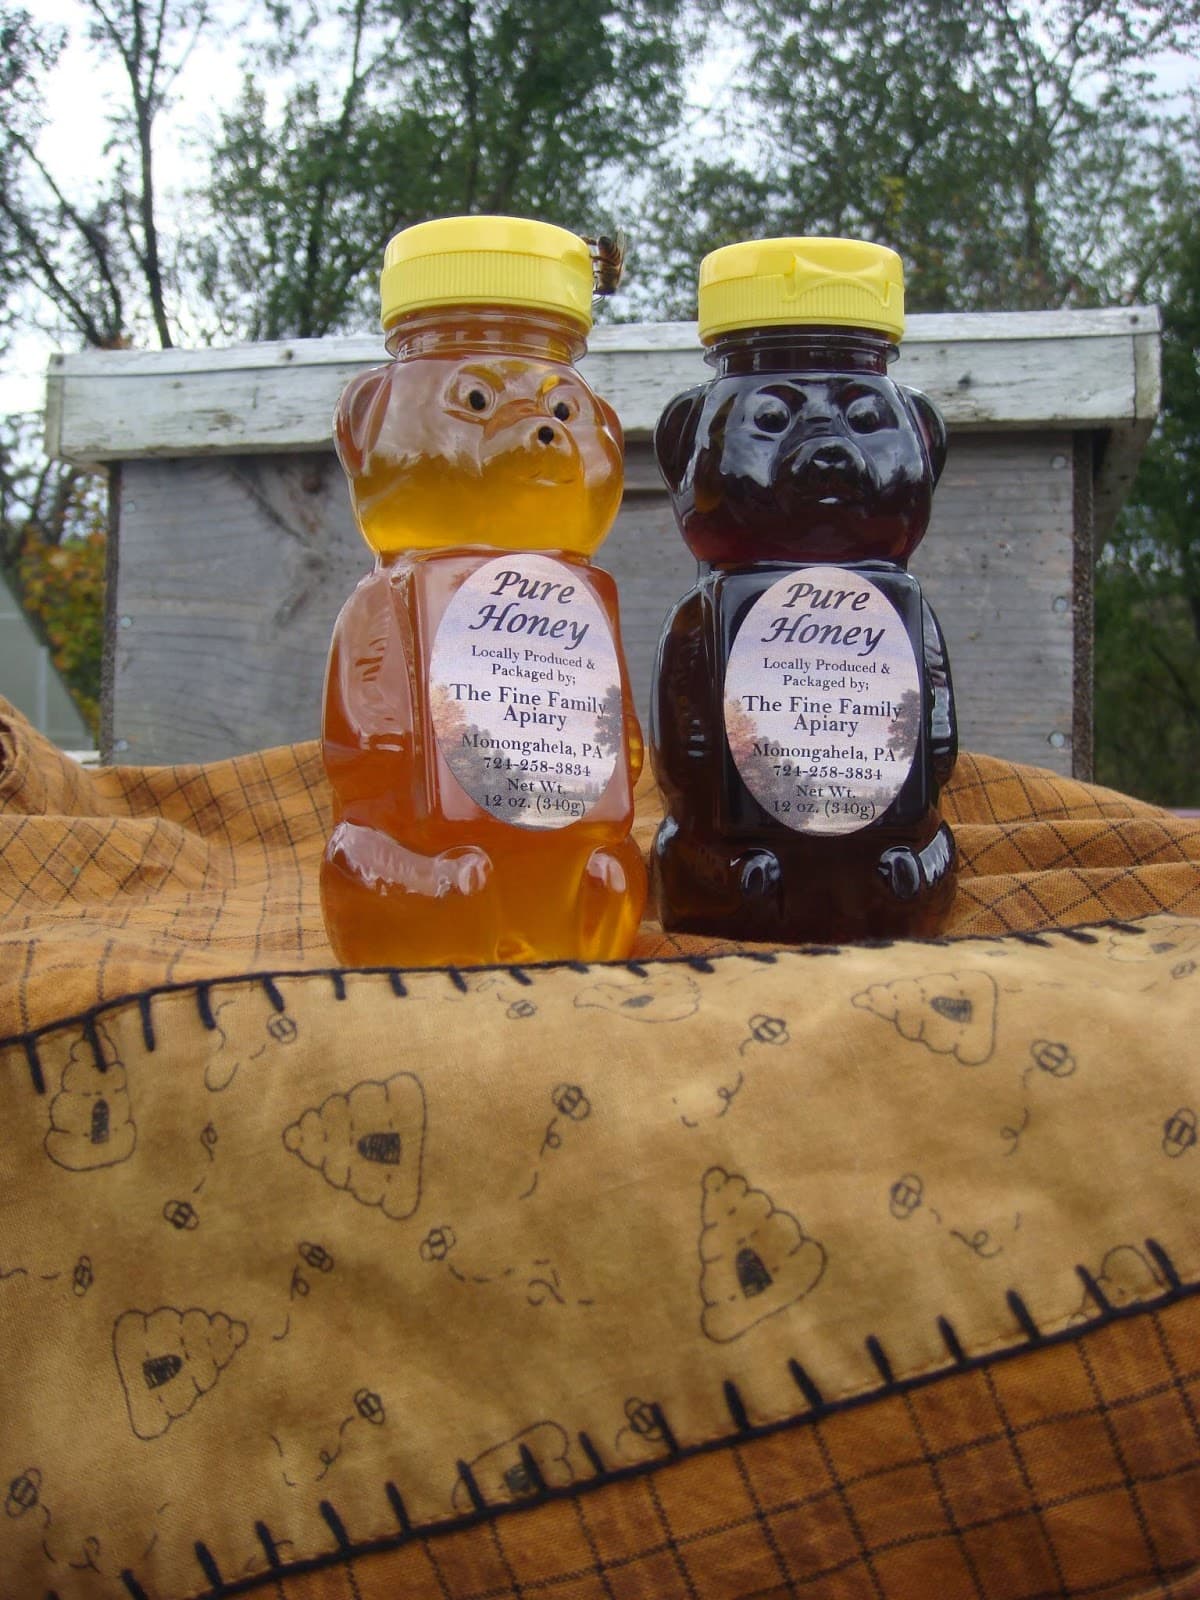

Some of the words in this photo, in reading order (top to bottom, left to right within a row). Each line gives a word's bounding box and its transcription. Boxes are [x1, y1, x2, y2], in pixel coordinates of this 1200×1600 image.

[490, 571, 575, 604] Pure
[782, 583, 870, 611] Pure
[468, 603, 589, 650] Honey
[761, 614, 885, 656] Honey
[472, 645, 519, 663] Locally
[524, 650, 582, 668] Produced
[587, 659, 595, 670] &
[763, 658, 811, 673] Locally
[816, 659, 876, 673] Produced
[881, 664, 890, 674] &
[492, 664, 553, 682] Packaged
[783, 675, 845, 691] Packaged
[450, 684, 491, 701] The
[499, 687, 541, 705] Fine
[548, 691, 606, 719] Family
[742, 695, 781, 712] The
[789, 697, 831, 713] Fine
[840, 699, 902, 722] Family
[504, 704, 567, 731] Apiary
[793, 714, 859, 737] Apiary
[462, 733, 576, 758] Monongahela,
[582, 743, 602, 759] PA
[752, 743, 868, 762] Monongahela,
[874, 748, 896, 761] PA
[483, 757, 591, 776] 724-258-3834
[773, 765, 882, 780] 724-258-3834
[508, 778, 534, 792] Net
[541, 781, 566, 794] Wt.
[796, 786, 824, 798] Net
[828, 786, 856, 798] Wt.
[485, 795, 500, 806] 12
[508, 798, 530, 808] oz.
[537, 795, 585, 816] (340g)
[773, 801, 790, 812] 12
[797, 803, 818, 813] oz.
[824, 800, 876, 819] (340g)
